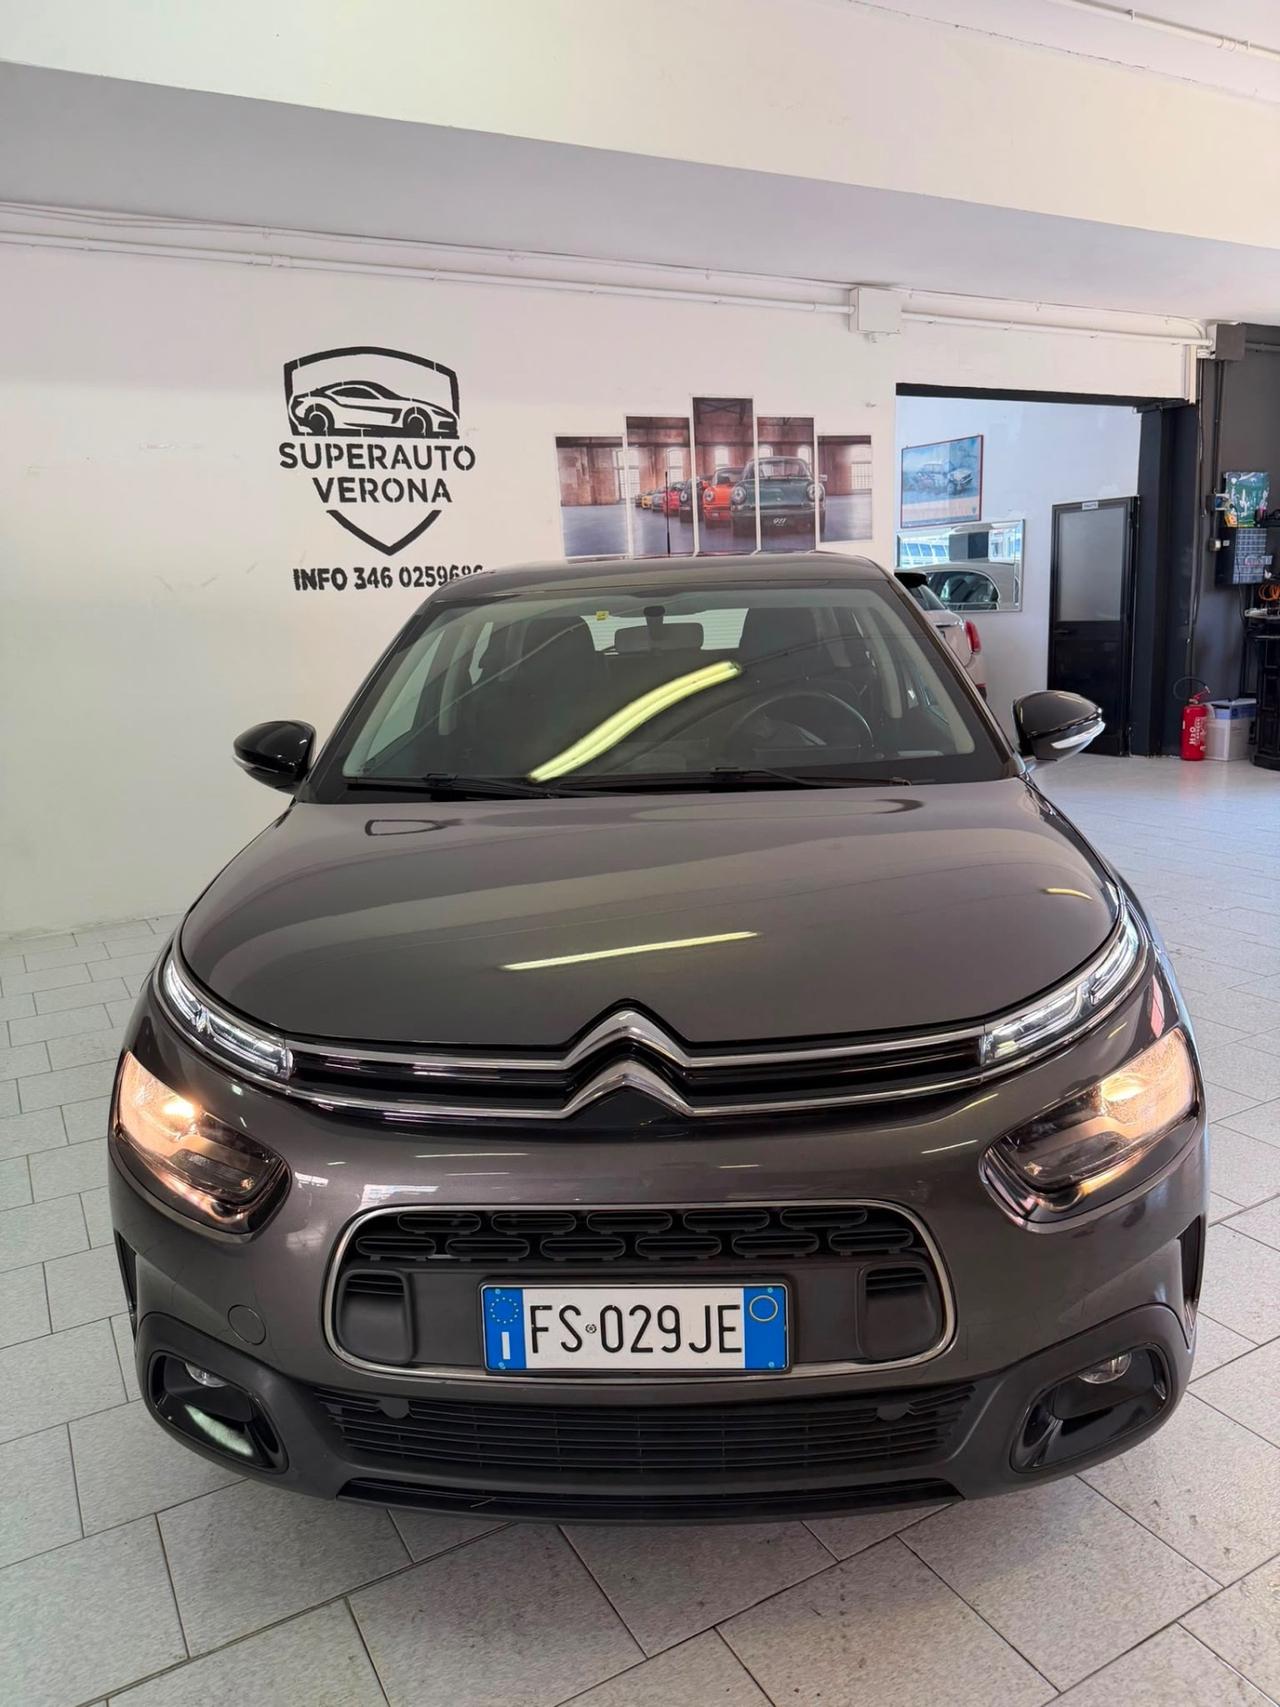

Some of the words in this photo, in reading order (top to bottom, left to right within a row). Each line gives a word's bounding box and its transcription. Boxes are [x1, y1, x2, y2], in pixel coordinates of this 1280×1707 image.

[279, 442, 476, 471] SUPERAUTO
[312, 476, 453, 504] VERONA
[293, 567, 348, 591] INFO
[354, 566, 393, 590] 346
